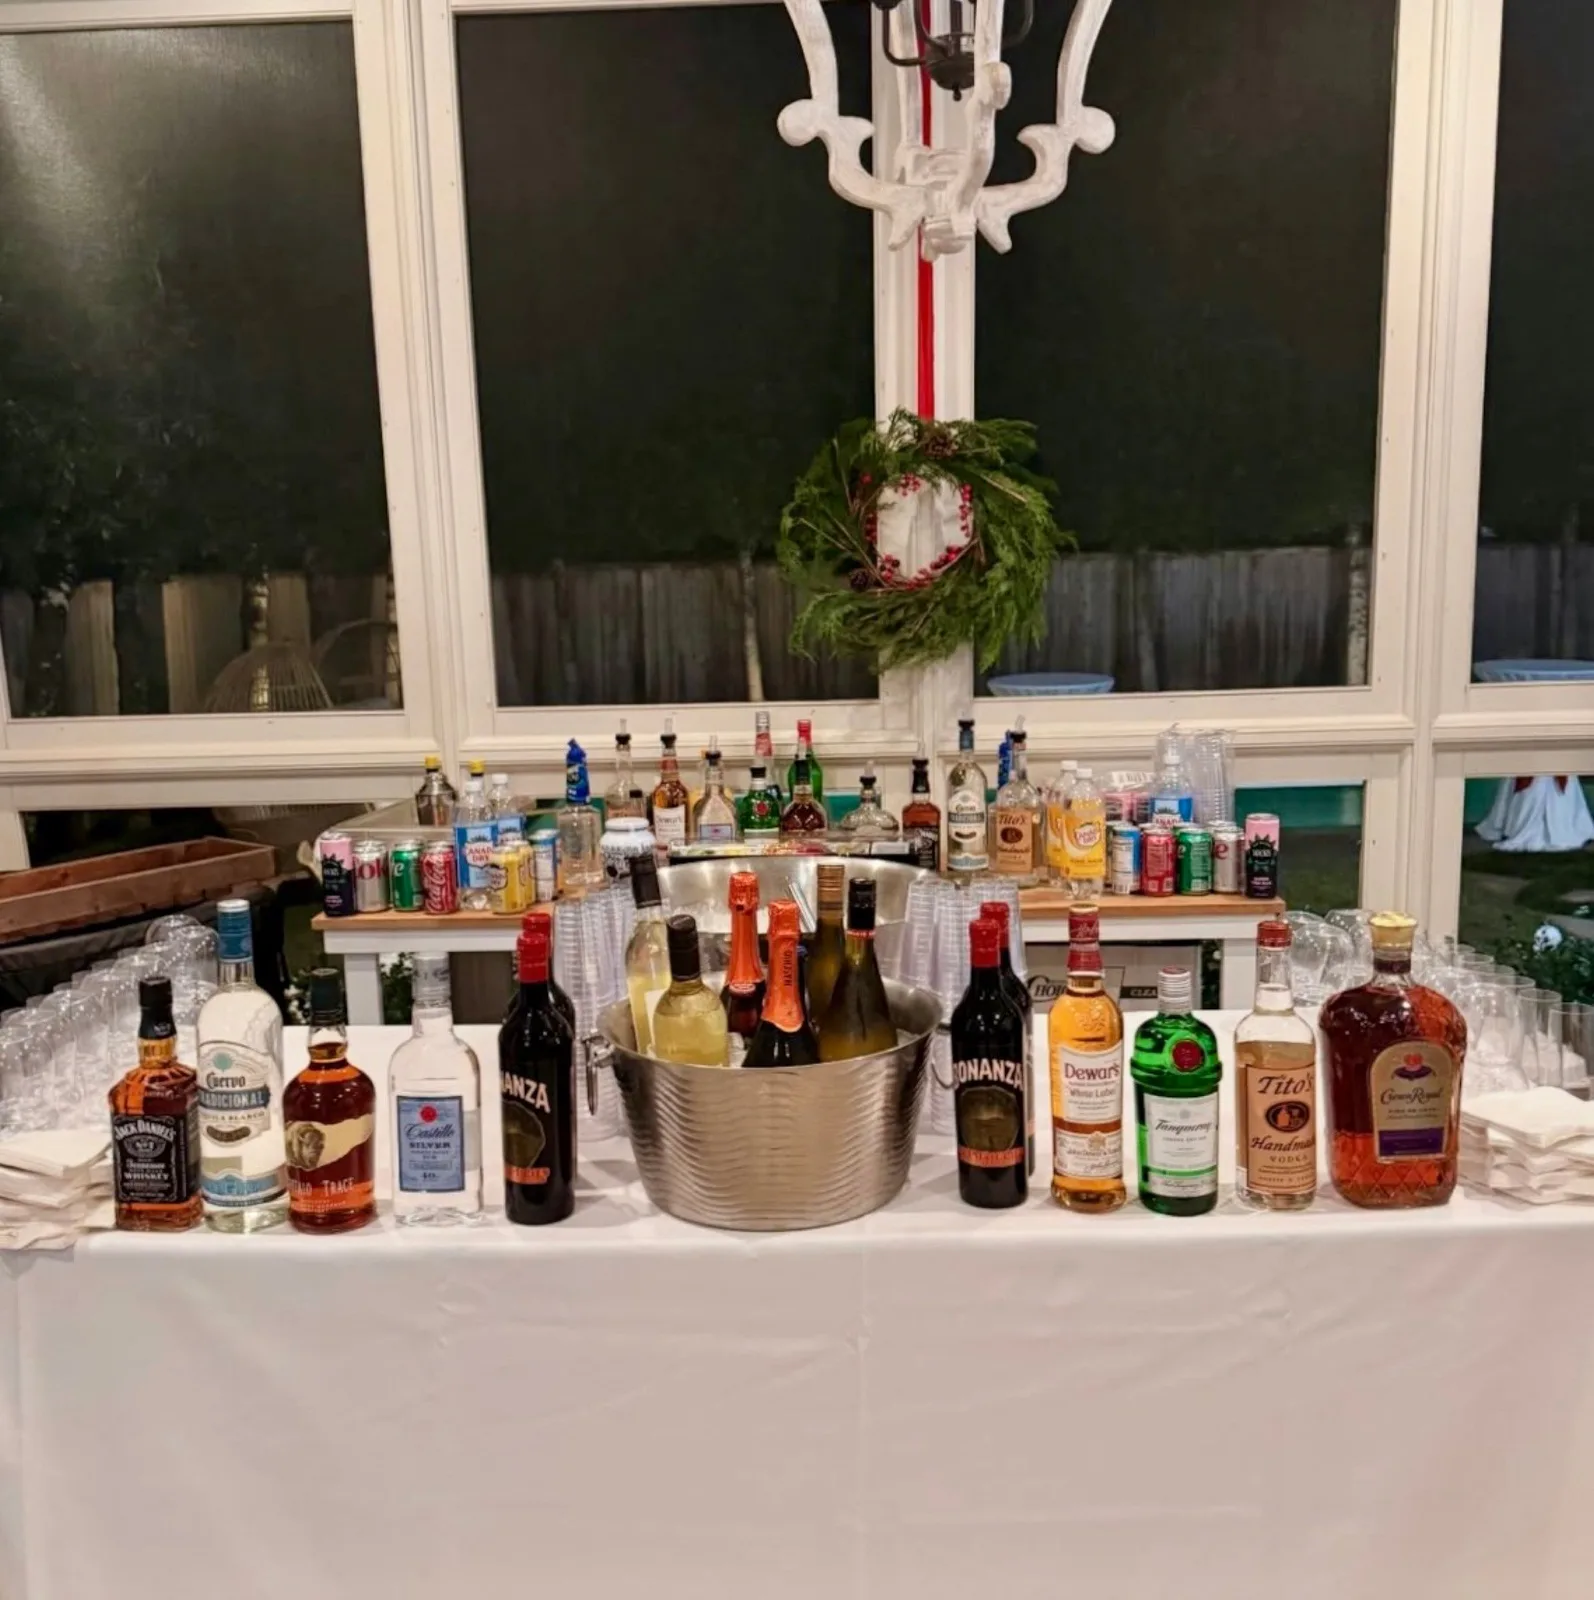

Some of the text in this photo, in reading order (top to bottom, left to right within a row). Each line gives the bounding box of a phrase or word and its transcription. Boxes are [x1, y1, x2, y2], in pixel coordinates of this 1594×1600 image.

[206, 1071, 246, 1089] Cuervo
[1063, 1062, 1120, 1080] Dewar's
[1257, 1072, 1314, 1096] Tito's
[404, 1123, 454, 1141] Castillo
[1155, 1119, 1213, 1135] Tanqueray
[1269, 1155, 1308, 1164] VODKA
[123, 1172, 170, 1181] WHISKEY
